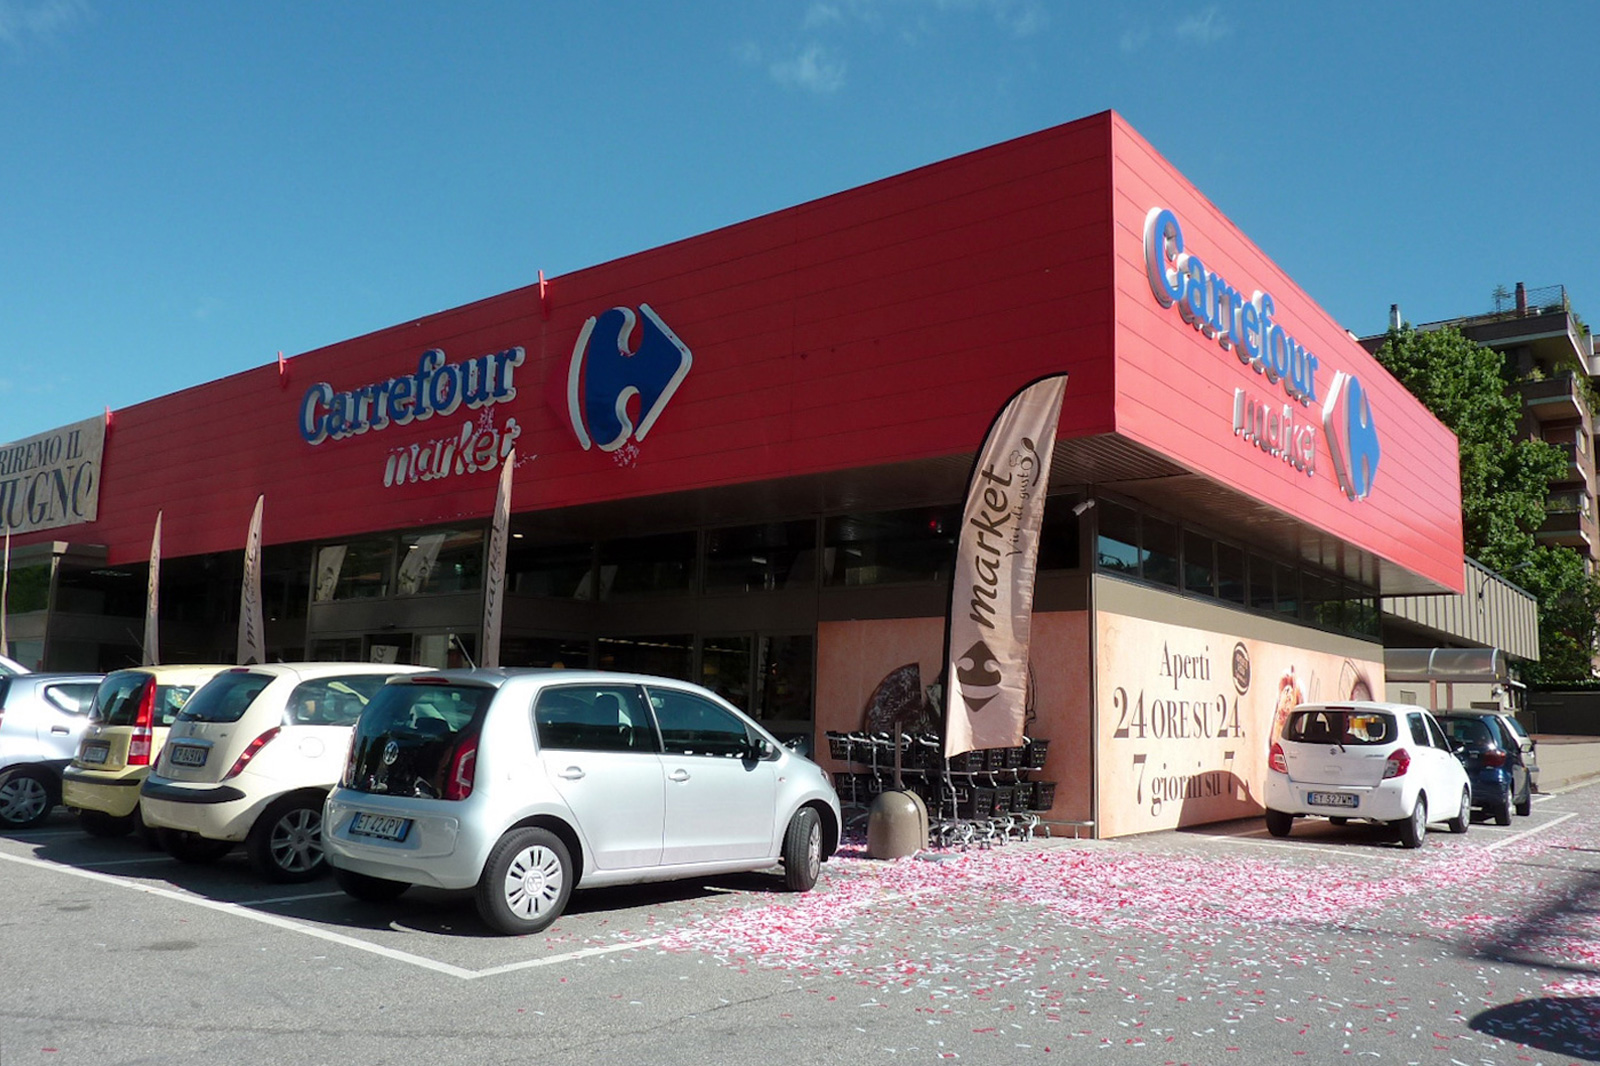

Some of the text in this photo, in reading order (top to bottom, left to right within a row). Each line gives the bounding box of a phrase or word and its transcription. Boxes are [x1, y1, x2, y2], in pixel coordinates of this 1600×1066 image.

[1143, 207, 1319, 407] Carrefour
[300, 347, 525, 445] Carrefour
[66, 430, 83, 460] IL
[384, 418, 520, 487] market
[1011, 505, 1023, 521] di
[970, 464, 1012, 629] market
[1005, 526, 1023, 557] Vivi
[1159, 640, 1210, 690] Aperti
[1113, 687, 1147, 738] 24
[1151, 699, 1191, 739] ORE
[1193, 701, 1213, 739] SU
[1133, 751, 1235, 817] 7 giorni su 7
[357, 814, 371, 830] ET
